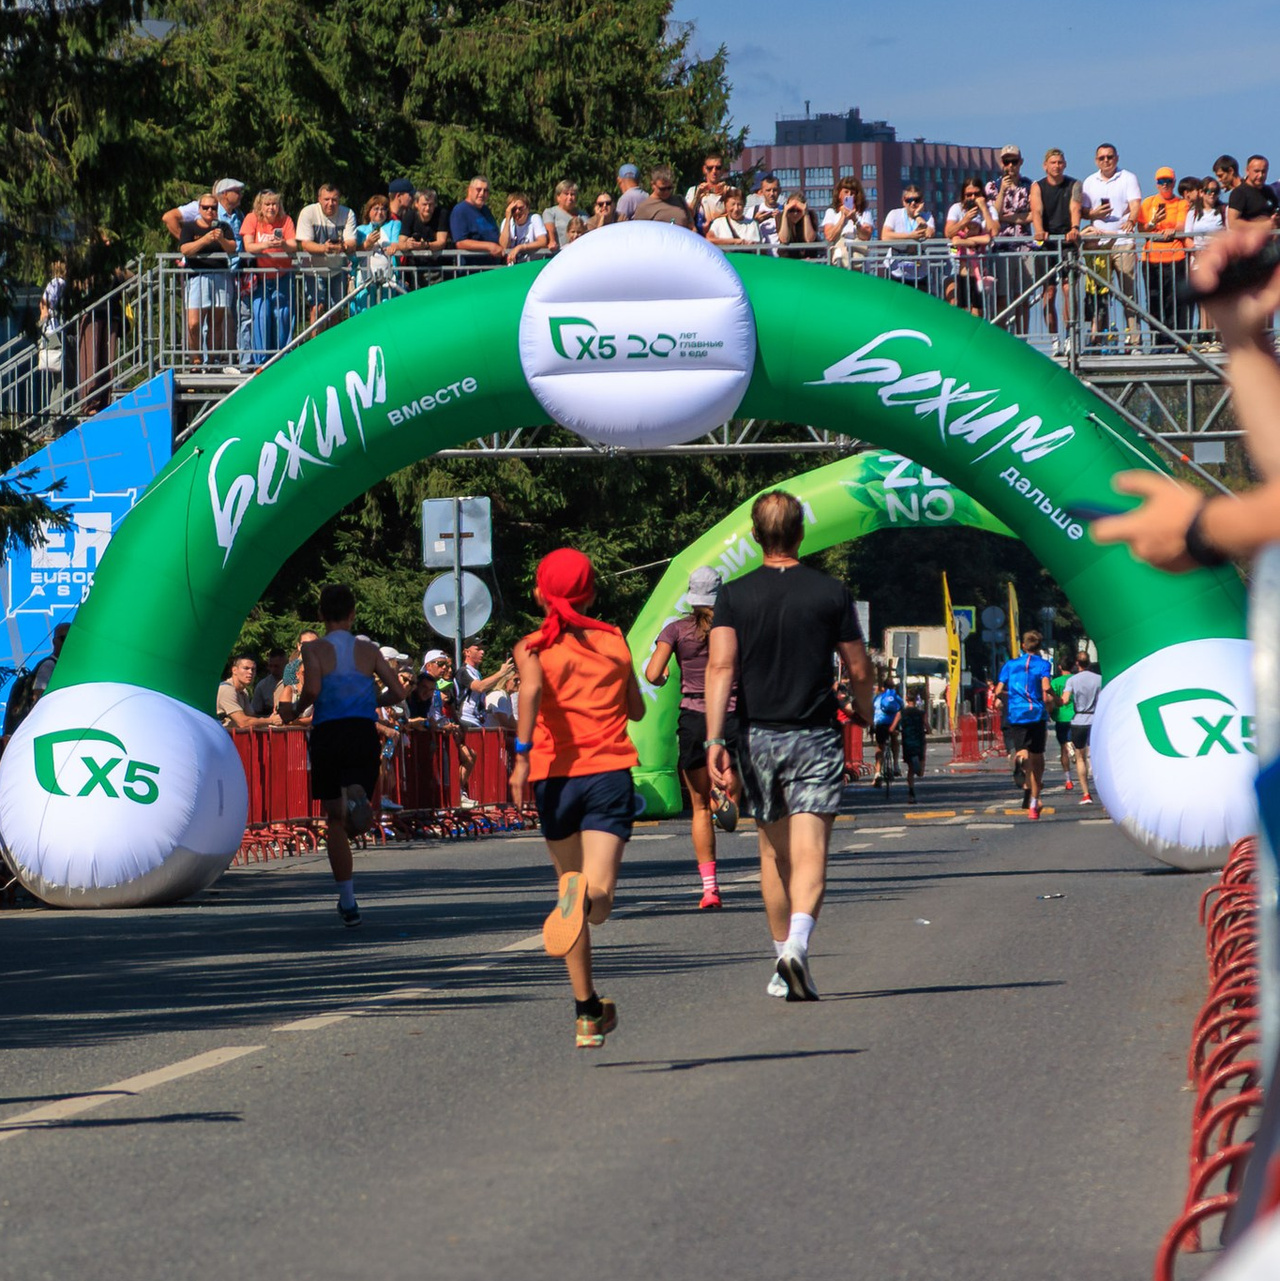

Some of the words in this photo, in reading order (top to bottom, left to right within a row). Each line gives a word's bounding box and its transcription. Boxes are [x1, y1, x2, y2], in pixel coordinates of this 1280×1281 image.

[576, 334, 617, 360] X5
[627, 333, 678, 359] 20
[679, 331, 698, 340] лет
[679, 340, 724, 350] главные
[679, 350, 687, 358] в
[688, 350, 708, 359] еде
[388, 376, 478, 427] вместе
[1000, 465, 1084, 540] дальше
[77, 756, 160, 805] X5
